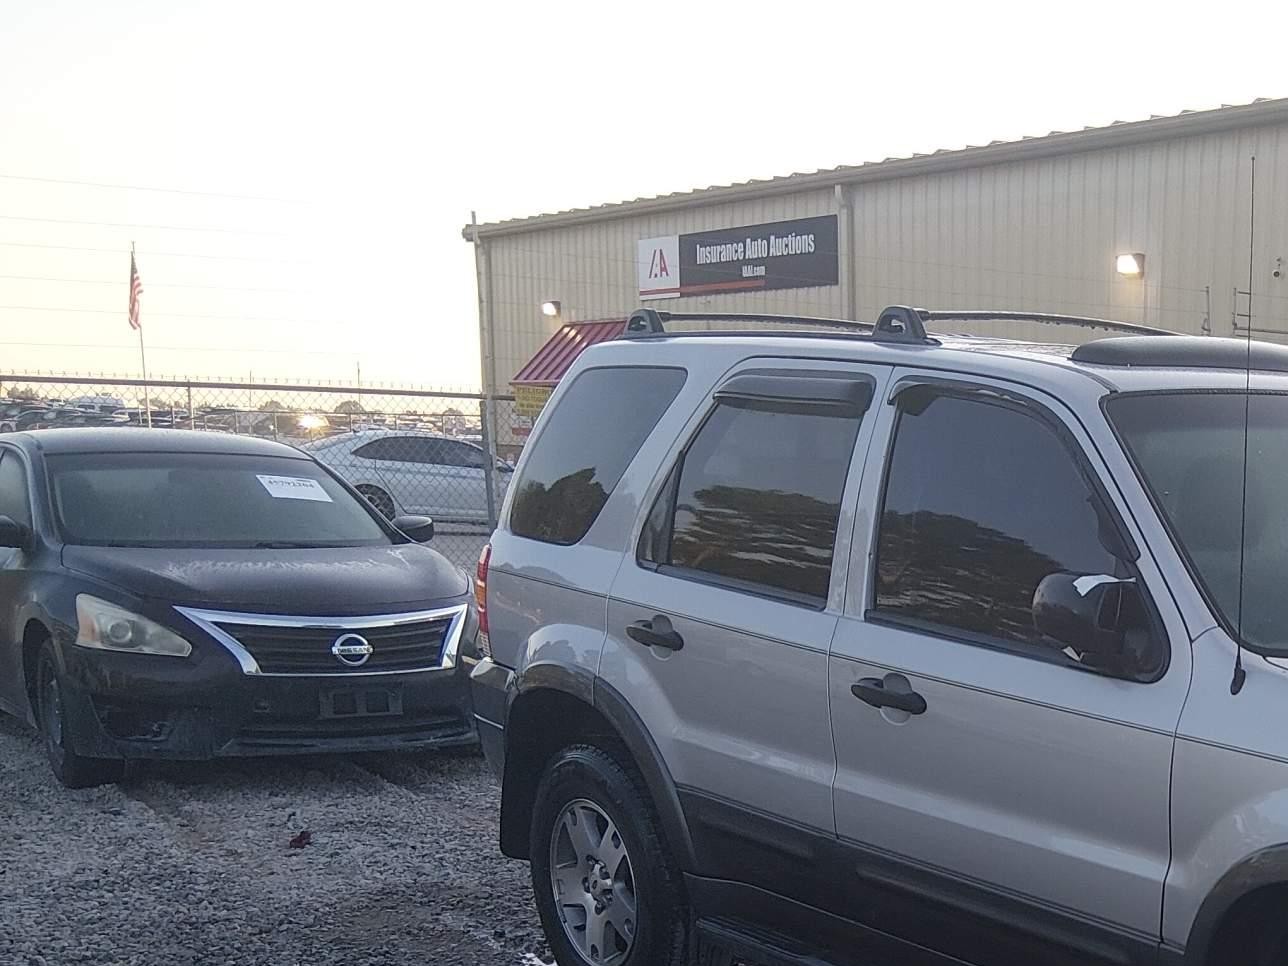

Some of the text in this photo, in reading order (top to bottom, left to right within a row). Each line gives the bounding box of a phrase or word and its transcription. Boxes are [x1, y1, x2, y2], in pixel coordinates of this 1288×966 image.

[696, 232, 816, 265] Insurance Auto Auctions
